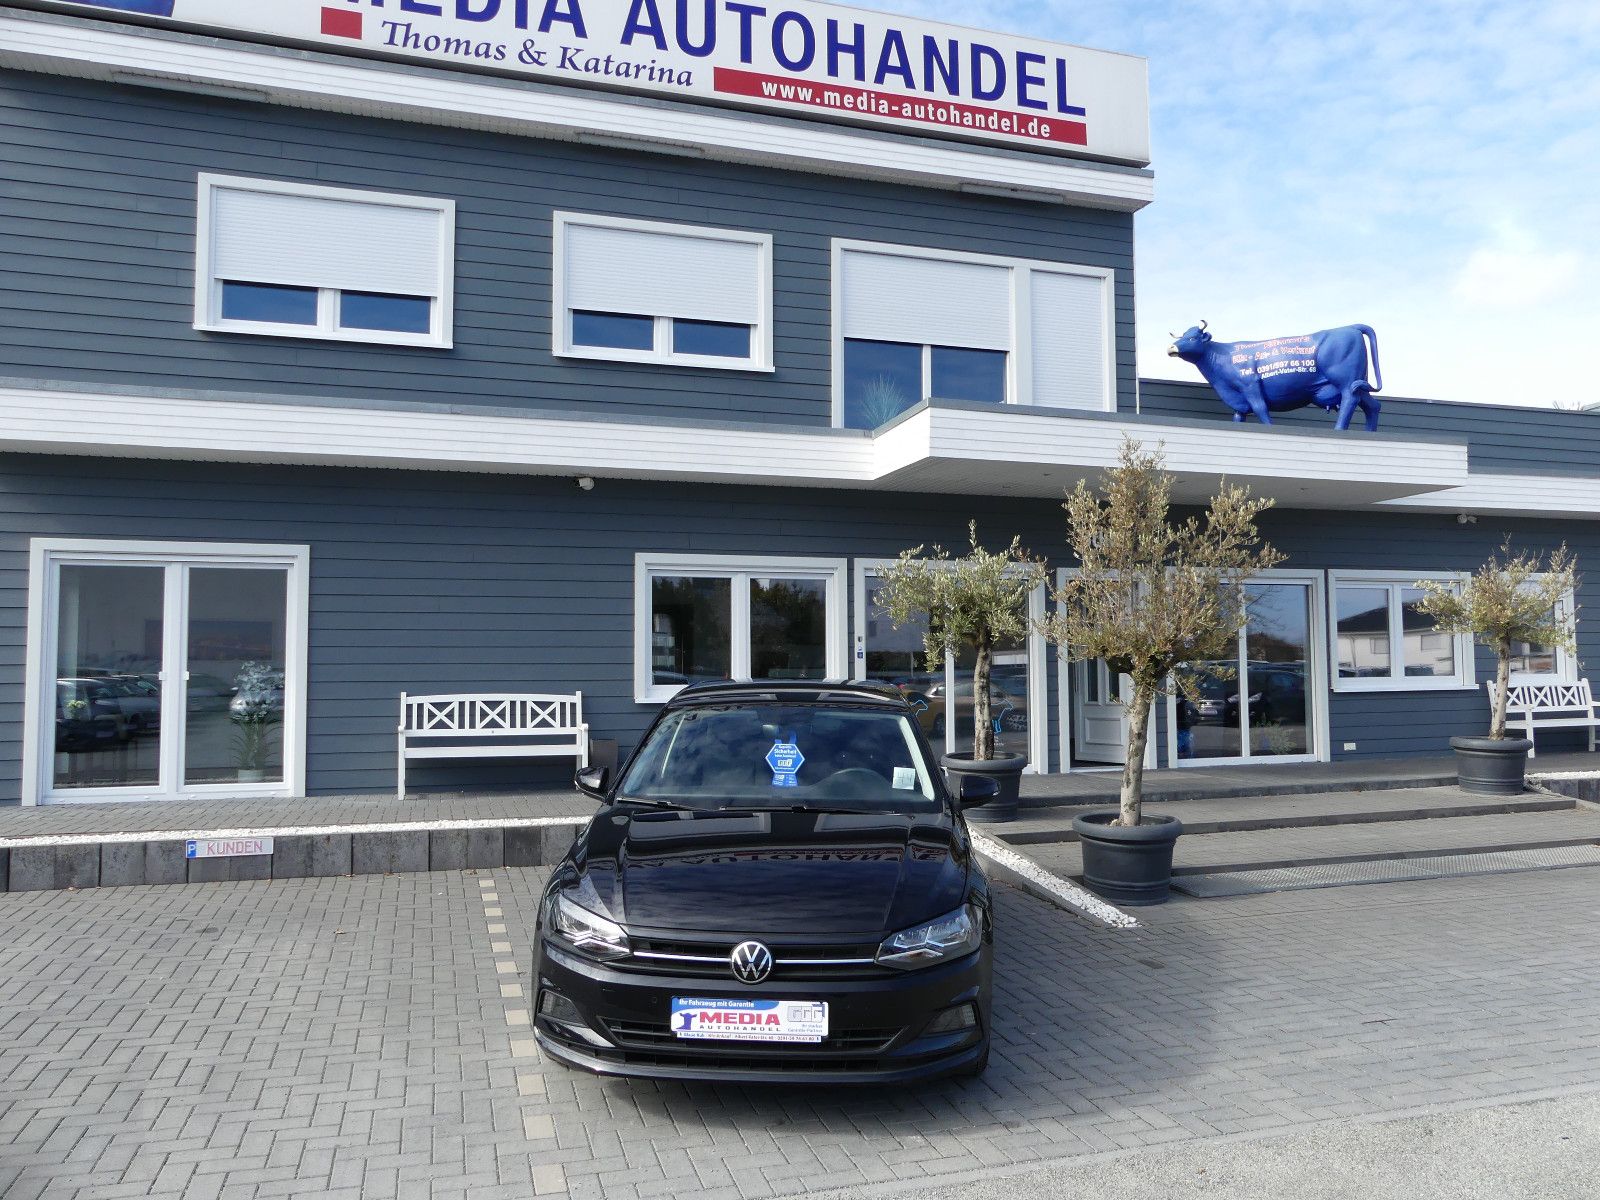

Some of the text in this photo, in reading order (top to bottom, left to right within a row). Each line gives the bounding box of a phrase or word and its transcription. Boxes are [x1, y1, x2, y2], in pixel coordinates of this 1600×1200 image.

[381, 20, 694, 88] Thomas & Katarina
[620, 0, 1087, 117] AUTOHANDEL
[761, 78, 1051, 138] www.media-autohandel.de
[1240, 367, 1255, 376] Tel.
[1301, 359, 1315, 367] 100
[207, 840, 263, 856] KUNDEN
[688, 999, 716, 1008] Fahrzeug
[728, 1000, 755, 1008] Garantie
[700, 1011, 781, 1026] MEDIA
